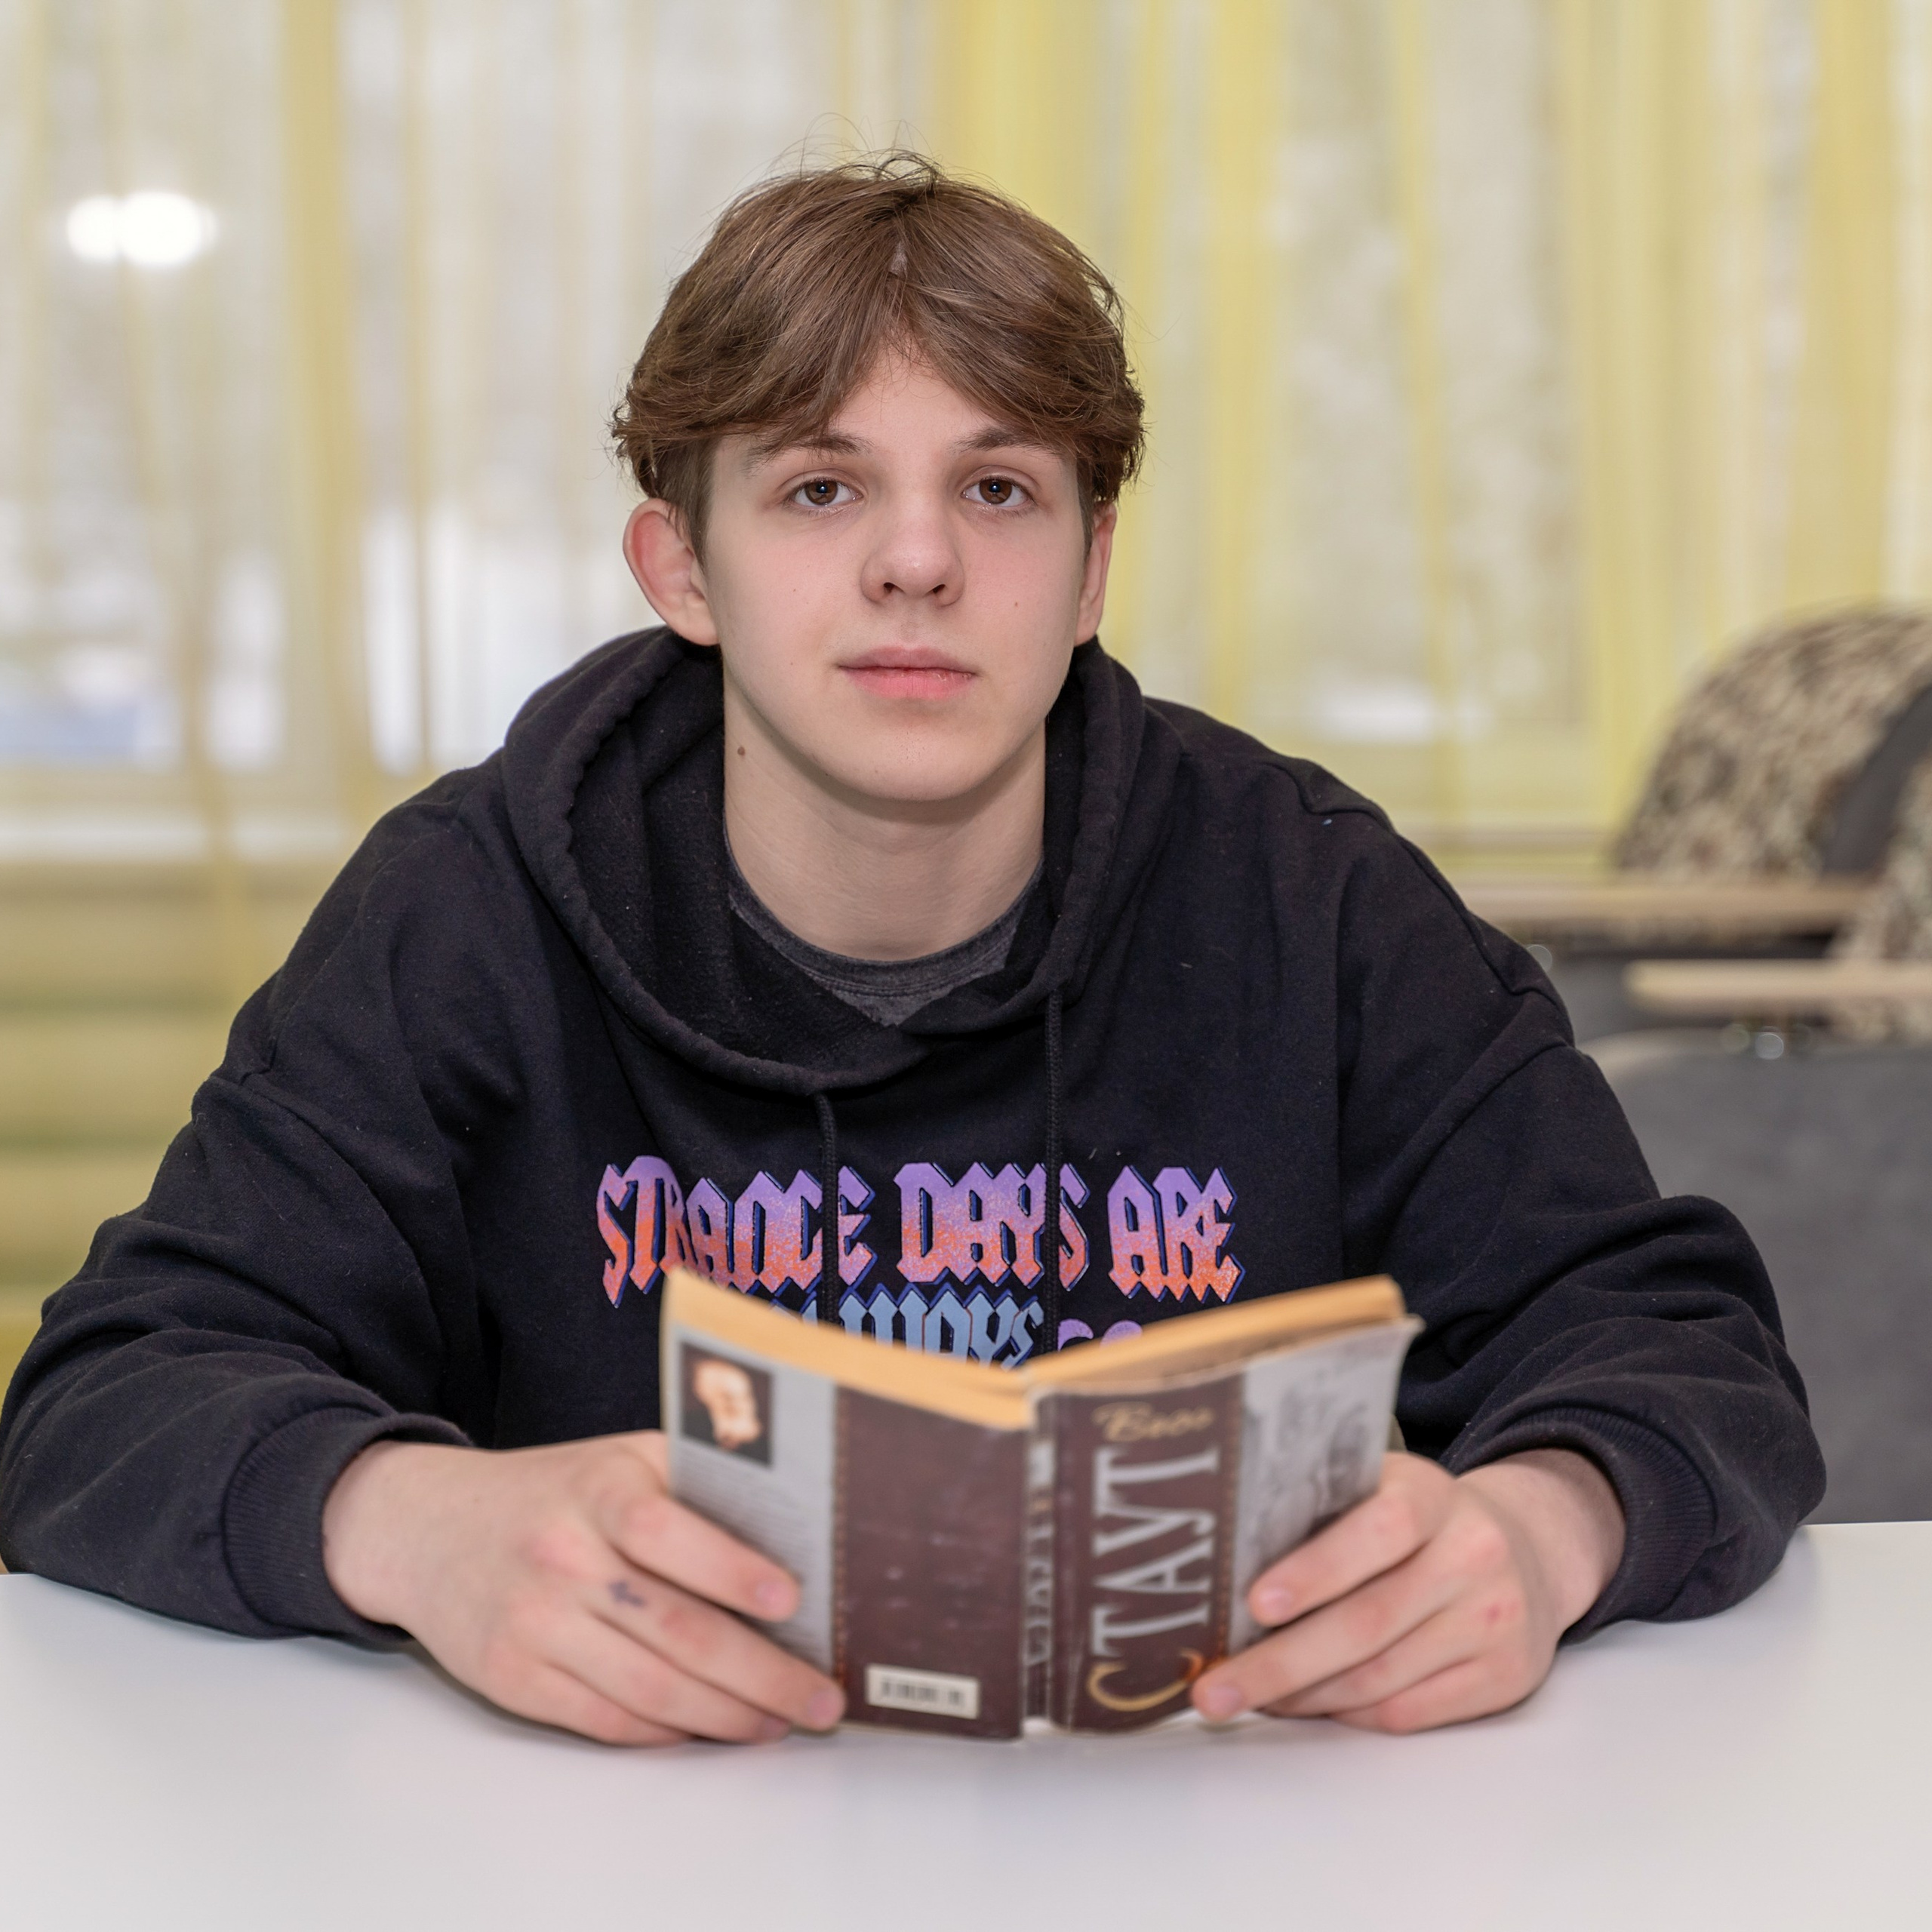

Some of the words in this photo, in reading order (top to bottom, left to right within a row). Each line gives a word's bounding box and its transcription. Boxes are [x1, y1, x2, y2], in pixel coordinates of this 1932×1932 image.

[894, 1161, 1090, 1291] DAYS
[1107, 1165, 1246, 1303] ARE
[1087, 1446, 1220, 1712] СТАУТ
